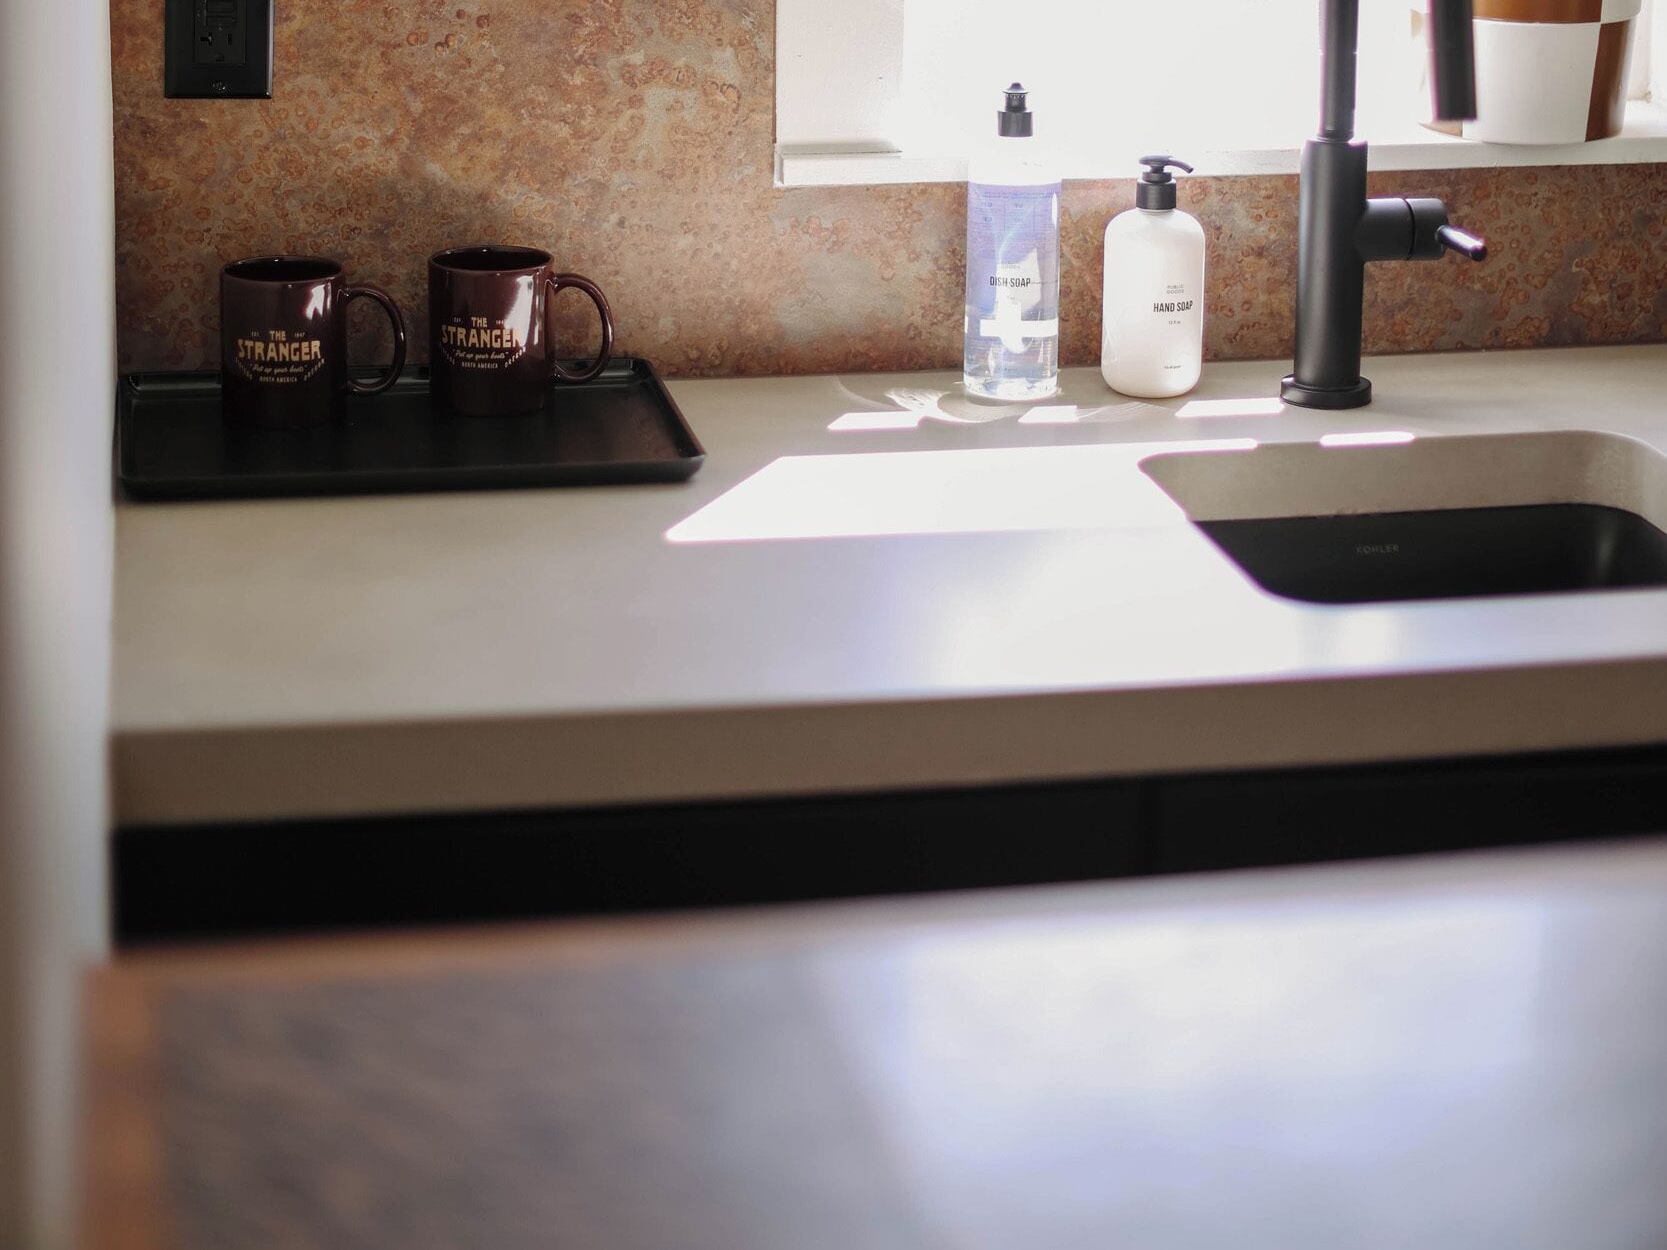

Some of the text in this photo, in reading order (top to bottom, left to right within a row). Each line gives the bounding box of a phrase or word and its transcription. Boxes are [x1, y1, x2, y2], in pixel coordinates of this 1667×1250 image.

[989, 276, 1031, 288] DISH SOAP
[1153, 300, 1193, 312] HAND SOAP
[471, 317, 487, 328] THE
[269, 330, 286, 341] THE
[237, 339, 321, 361] STRANGER
